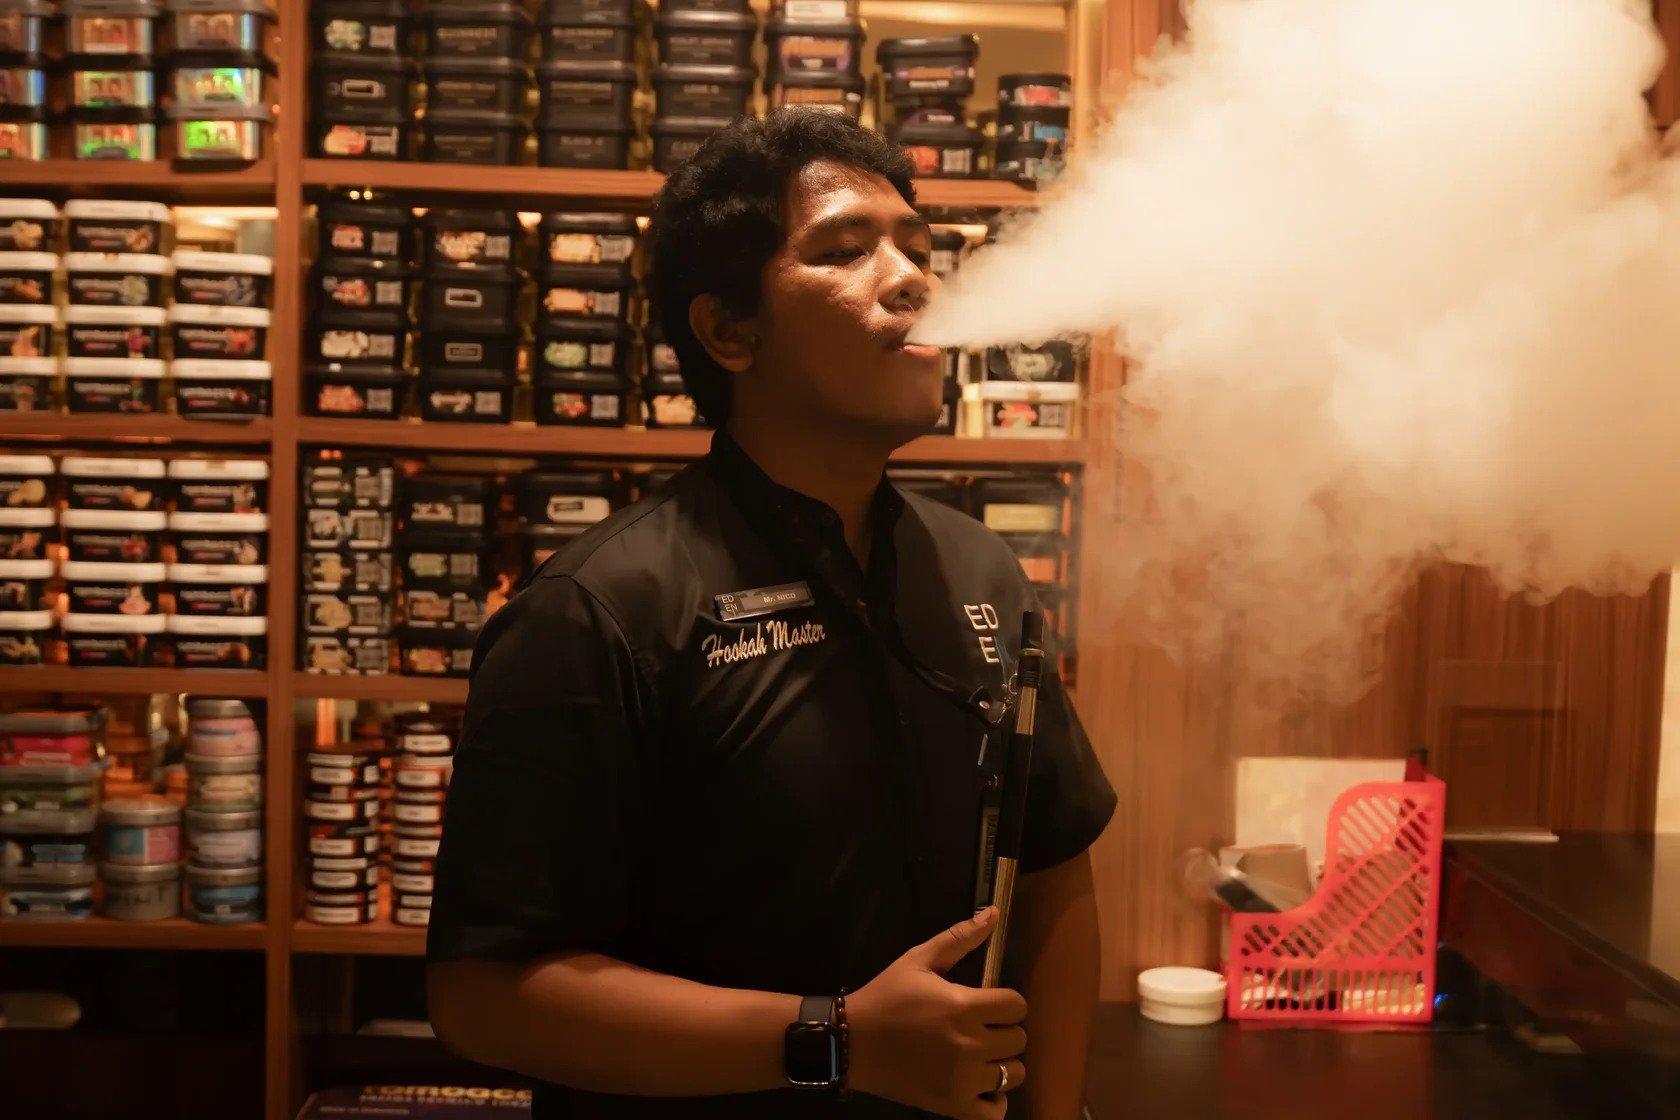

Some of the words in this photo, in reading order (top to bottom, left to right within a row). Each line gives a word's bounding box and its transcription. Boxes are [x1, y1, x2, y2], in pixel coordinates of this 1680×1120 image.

[721, 594, 734, 604] ED
[763, 596, 776, 604] Mr.
[777, 592, 796, 602] NICO
[725, 603, 738, 615] EN
[963, 603, 999, 630] ED
[701, 622, 767, 668] Hookah
[766, 620, 826, 650] Master
[978, 636, 1000, 663] E
